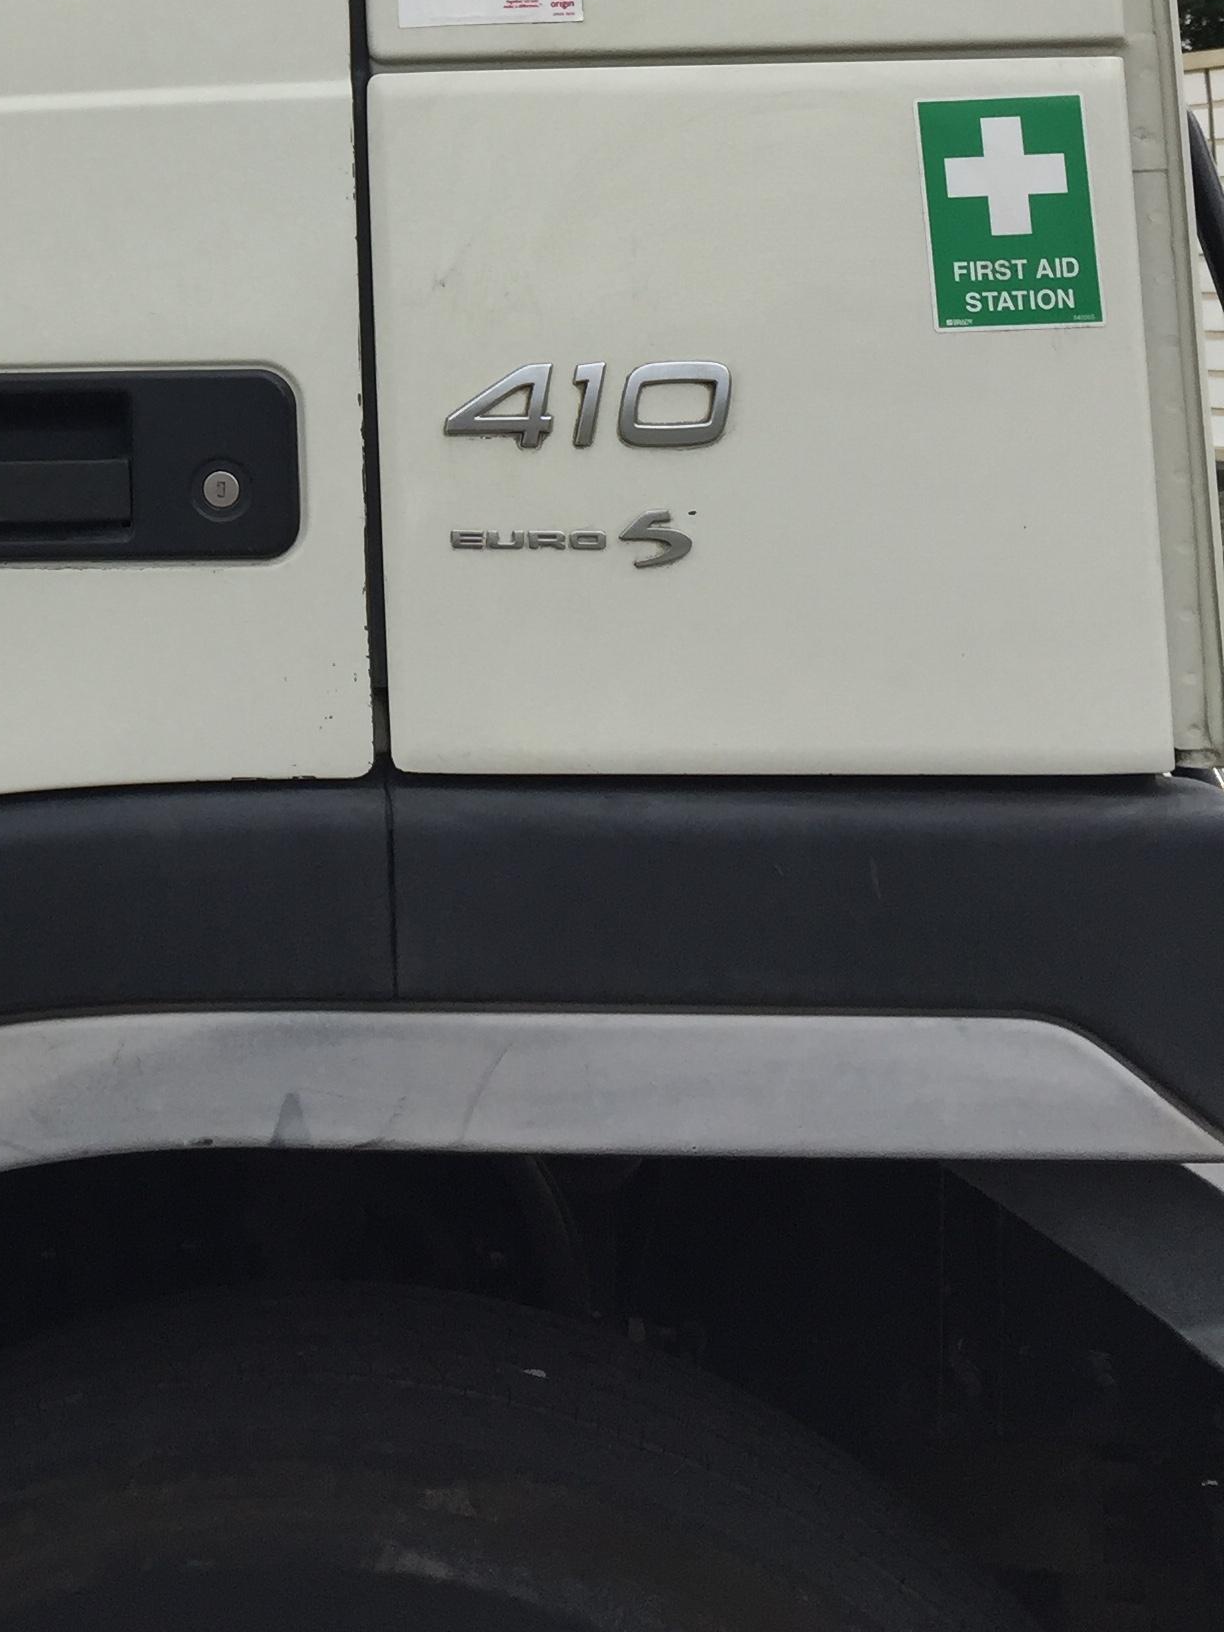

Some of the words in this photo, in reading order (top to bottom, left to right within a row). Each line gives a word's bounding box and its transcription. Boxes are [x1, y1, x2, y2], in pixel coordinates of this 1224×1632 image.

[550, 0, 575, 10] origin
[952, 258, 1027, 282] FIRST
[1036, 257, 1080, 279] AID
[965, 288, 1076, 313] STATION
[443, 360, 733, 449] 410
[450, 529, 607, 550] EURO
